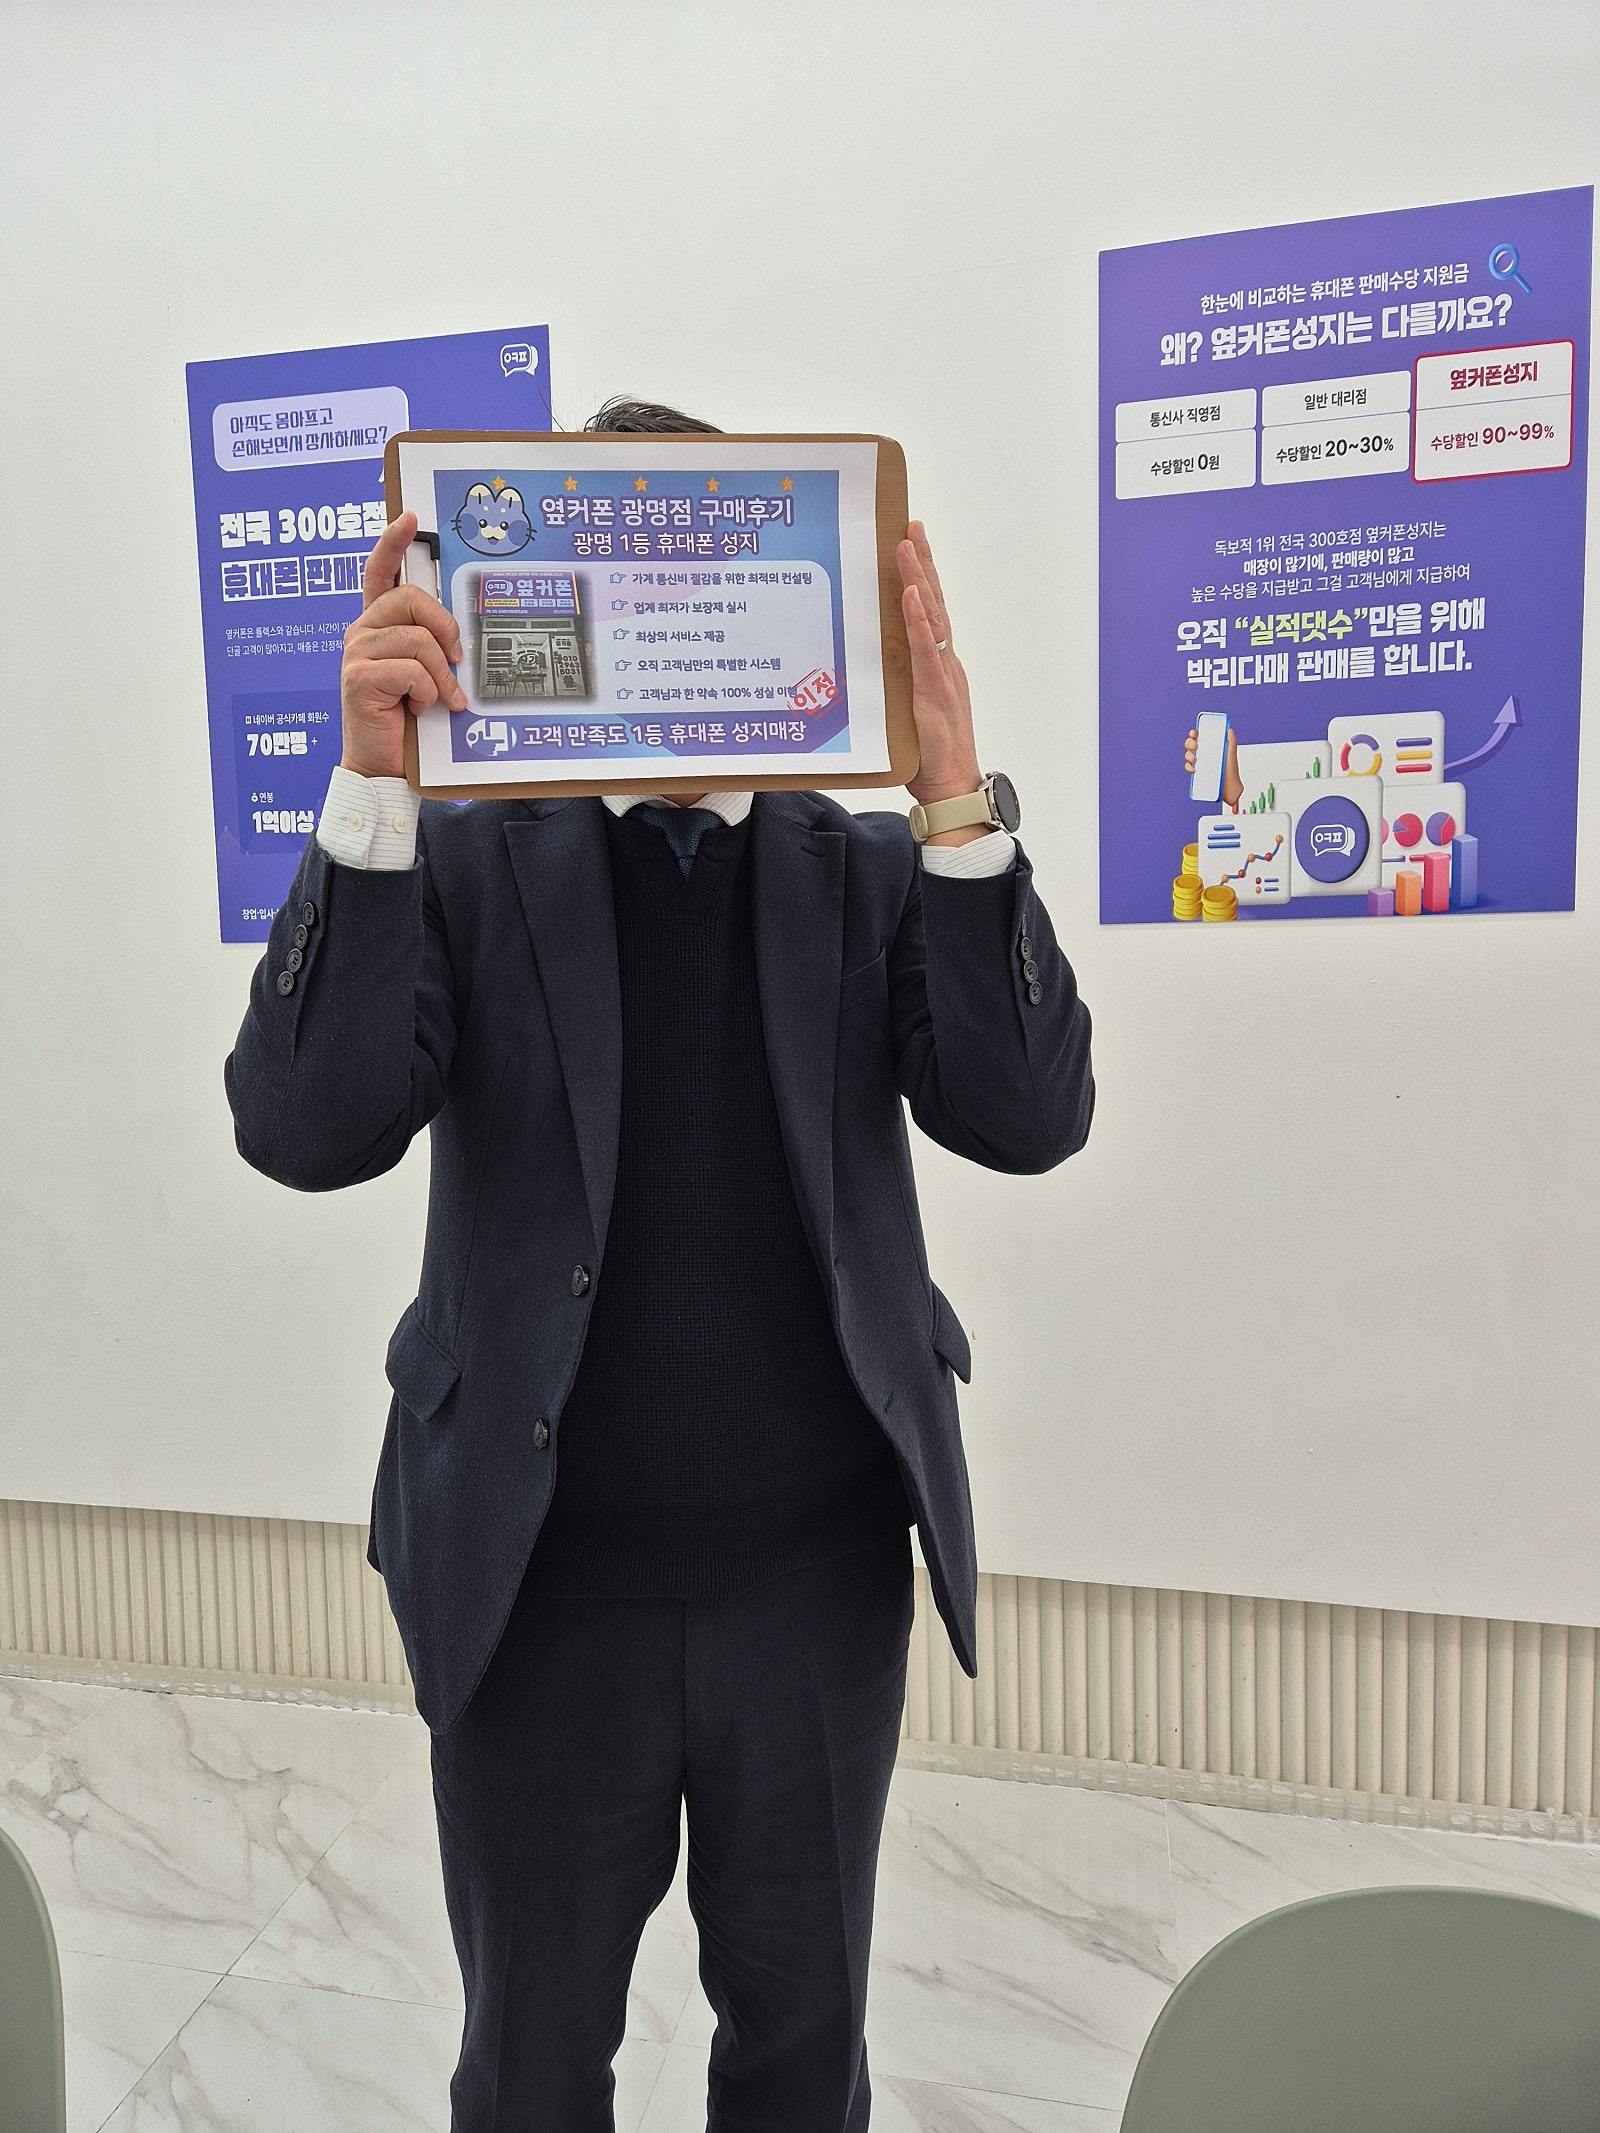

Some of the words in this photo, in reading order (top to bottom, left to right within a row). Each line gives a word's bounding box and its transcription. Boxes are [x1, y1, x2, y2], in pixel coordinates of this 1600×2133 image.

[1201, 293, 1243, 315] 한눈에
[1249, 284, 1306, 308] 비교하는
[1310, 277, 1354, 302] 휴대폰
[1359, 269, 1419, 296] 판매수당
[1423, 263, 1468, 287] 지원금
[1160, 331, 1202, 366] 왜?
[1211, 312, 1373, 360] 옆커폰성지는
[1382, 293, 1512, 339] 다를까요?
[1450, 361, 1538, 390] 옆커폰성지
[1304, 392, 1328, 410] 일반
[1332, 388, 1367, 407] 대리점
[230, 413, 272, 434] 아직도
[276, 408, 333, 430] 몸아프고
[1150, 410, 1184, 428] 통신사
[1188, 405, 1221, 422] 직영점
[232, 434, 302, 458] 손해보면서
[306, 426, 388, 450] 장사하세요?
[1276, 445, 1322, 464] 수당할인
[1325, 435, 1394, 459] 20~30%
[1431, 431, 1478, 451] 수당할인
[1482, 422, 1554, 444] 90~99%
[1151, 458, 1194, 476] 수당할인
[1198, 454, 1220, 471] 0원
[220, 510, 271, 548] 전국
[278, 500, 388, 544] 300호점
[542, 498, 614, 526] 옆커폰
[621, 499, 692, 526] 광명점
[699, 498, 792, 526] 구매후기
[573, 533, 613, 555] 광명
[619, 534, 651, 554] 1등
[656, 533, 715, 555] 휴대폰
[720, 533, 758, 555] 성지
[1214, 537, 1252, 556] 독보적
[1256, 536, 1275, 554] 1위
[1279, 533, 1305, 551] 전국
[1309, 528, 1362, 548] 300호점
[1366, 521, 1447, 544] 옆커폰성지는
[1244, 558, 1282, 576] 매장이
[1285, 555, 1328, 574] 많기에,
[1331, 550, 1384, 570] 판매량이
[1388, 547, 1414, 564] 많고
[223, 560, 300, 600] 휴대폰
[516, 579, 572, 597] 옆커폰
[632, 572, 654, 585] 가계
[656, 572, 688, 585] 통신비
[690, 572, 722, 585] 절감을
[724, 572, 745, 585] 위한
[748, 572, 779, 585] 최적의
[781, 572, 813, 585] 컨설팅
[1191, 586, 1216, 603] 높은
[1220, 581, 1258, 600] 수당을
[1262, 578, 1313, 597] 지급받고
[1316, 574, 1342, 592] 그걸
[1346, 568, 1412, 589] 고객님에게
[1416, 564, 1470, 584] 지급하여
[634, 602, 655, 614] 업계
[658, 602, 690, 614] 최저가
[692, 601, 724, 614] 보장제
[726, 601, 747, 614] 실시
[226, 628, 254, 640] 옆커폰은
[286, 624, 316, 636] 같습니다.
[318, 622, 340, 634] 시간이
[342, 622, 350, 631] 지
[636, 631, 667, 643] 최상의
[670, 630, 702, 643] 서비스
[704, 630, 725, 643] 제공
[1176, 618, 1228, 652] 오직
[1235, 603, 1422, 646] “실적댓수”만을
[1430, 597, 1486, 633] 위해
[226, 645, 241, 657] 단골
[243, 644, 264, 655] 고객이
[265, 643, 296, 655] 많아지고,
[298, 641, 319, 653] 매출은
[321, 640, 344, 652] 간정적
[637, 659, 658, 672] 오직
[661, 659, 713, 671] 고객님만의
[716, 658, 747, 671] 특별한
[750, 658, 780, 670] 시스템
[1187, 653, 1289, 689] 박리다매
[1297, 648, 1375, 684] 판매를
[1384, 640, 1472, 676] 합니다.
[639, 687, 681, 700] 고객님과
[684, 687, 694, 700] 한
[696, 687, 718, 700] 약속
[721, 687, 751, 698] 100%
[754, 686, 774, 699] 성실
[794, 672, 838, 716] 인정
[253, 715, 275, 725] 네이버
[277, 713, 306, 724] 공식카페
[307, 712, 329, 723] 회원수
[247, 731, 308, 756] 70만명
[523, 726, 563, 747] 고객
[567, 725, 627, 747] 만족도
[632, 724, 664, 745] 1등
[669, 723, 727, 744] 휴대폰
[731, 720, 806, 742] 성지매장
[259, 792, 274, 803] 연봉
[252, 810, 314, 834] 1억이상
